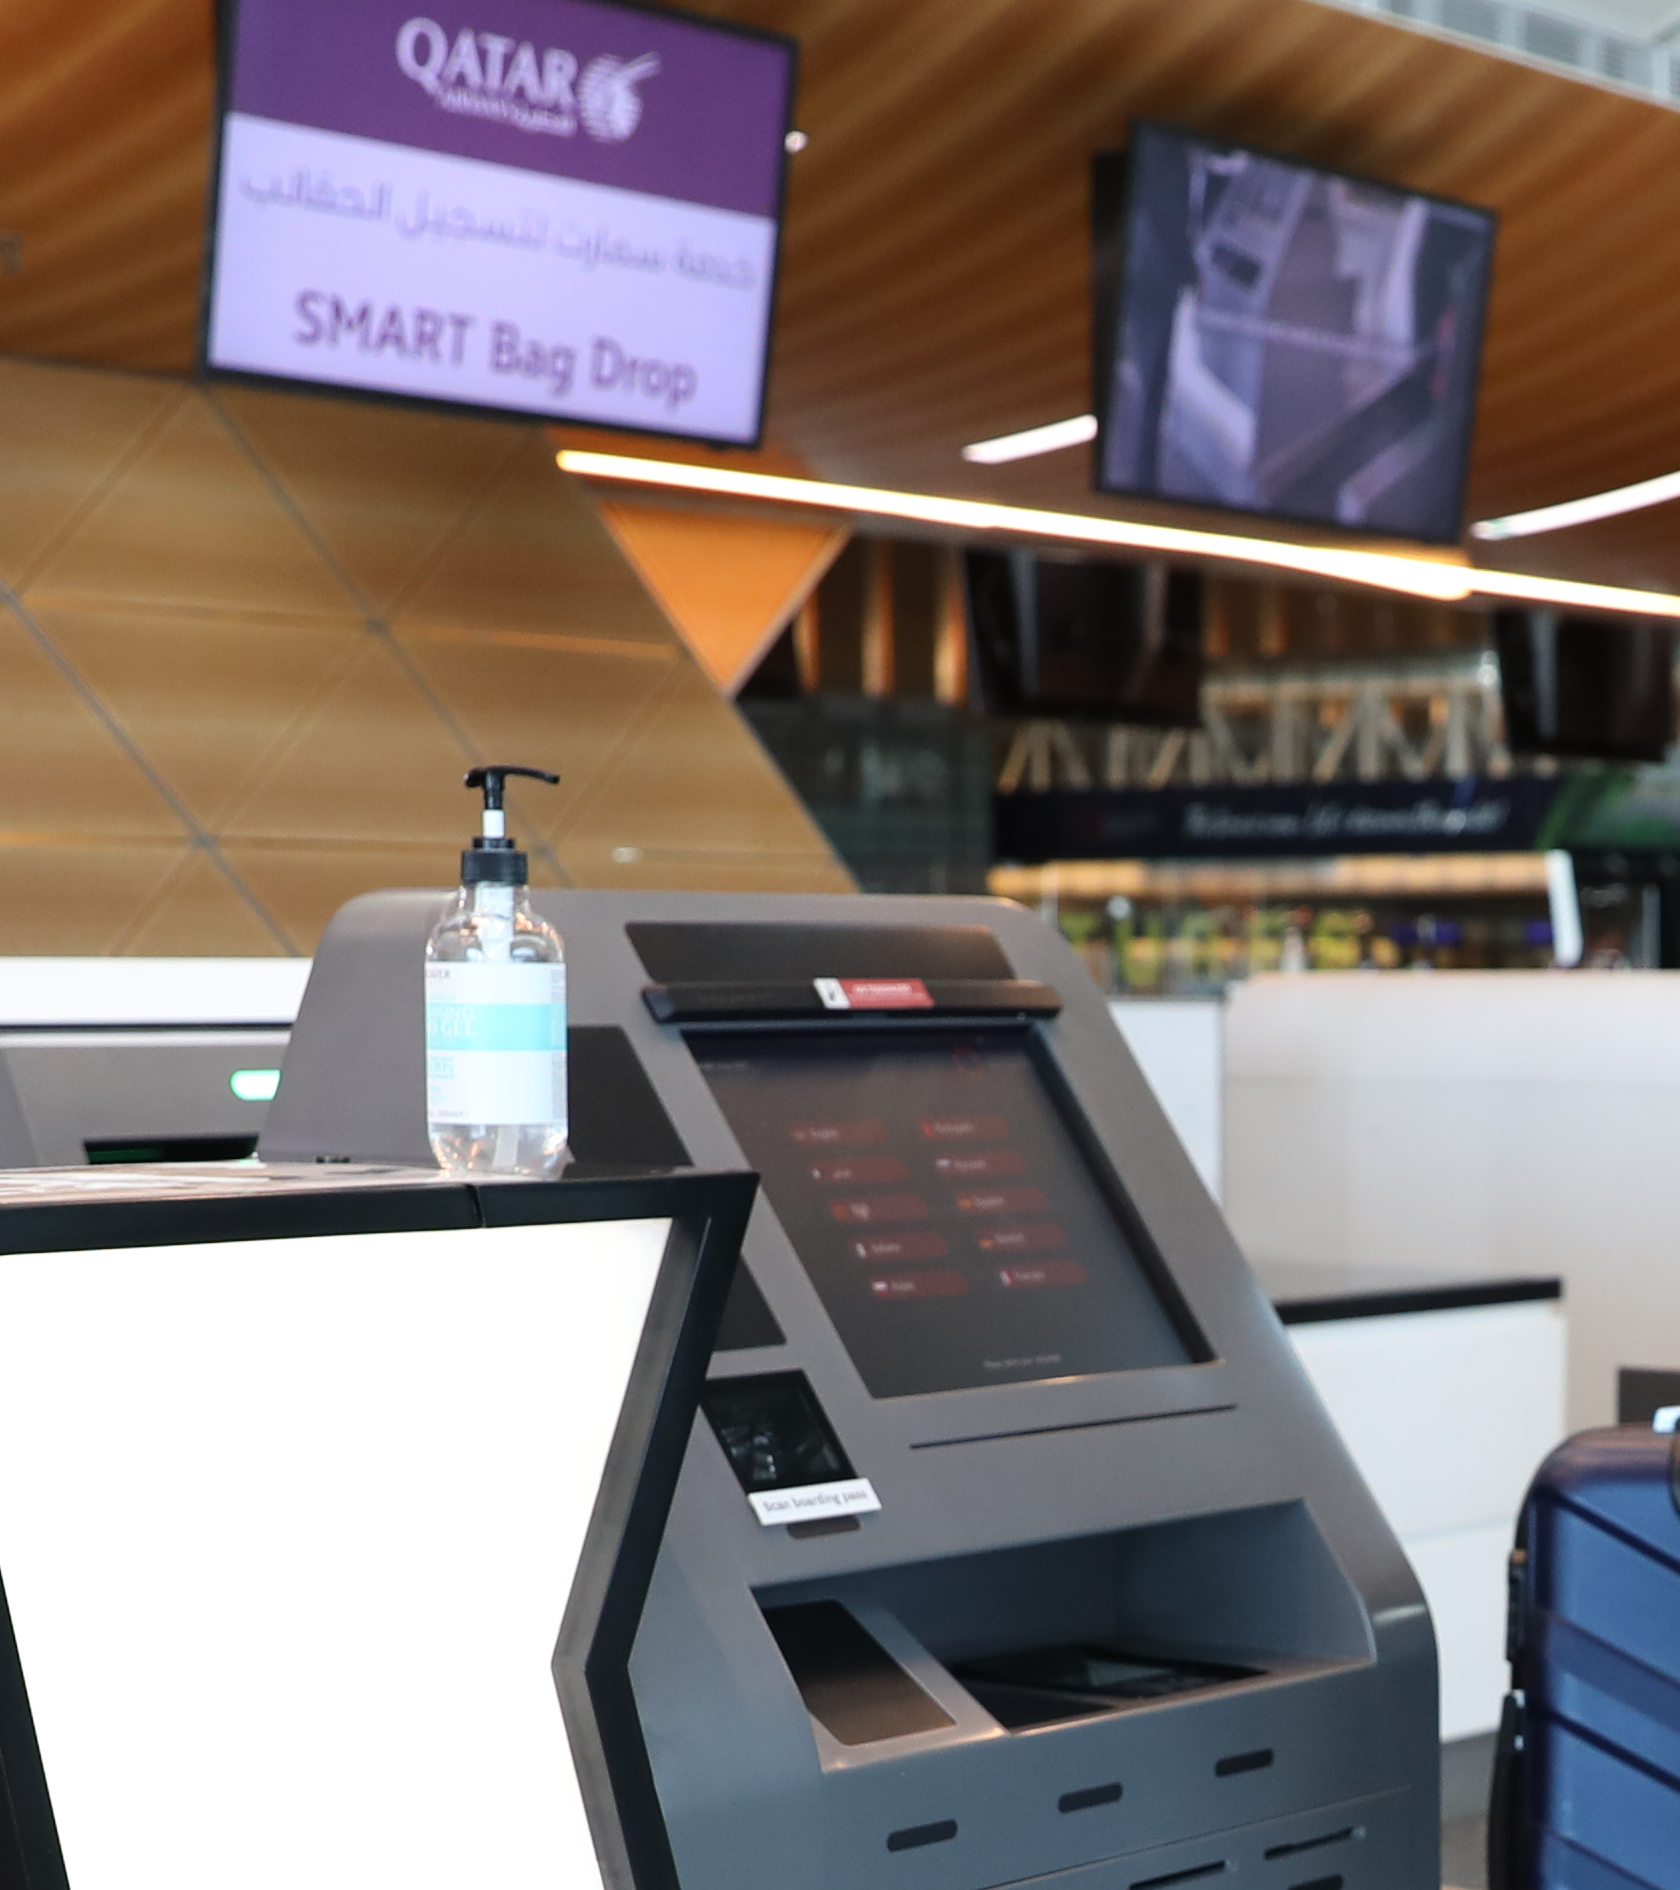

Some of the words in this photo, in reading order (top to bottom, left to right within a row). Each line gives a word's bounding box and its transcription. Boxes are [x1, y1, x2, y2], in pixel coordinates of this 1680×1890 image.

[396, 17, 578, 112] QATAR
[294, 289, 474, 365] SMART
[489, 320, 576, 397] Bag
[591, 337, 699, 405] Drop
[763, 1500, 792, 1512] Scan
[793, 1492, 841, 1507] boarding
[842, 1490, 869, 1502] pass
